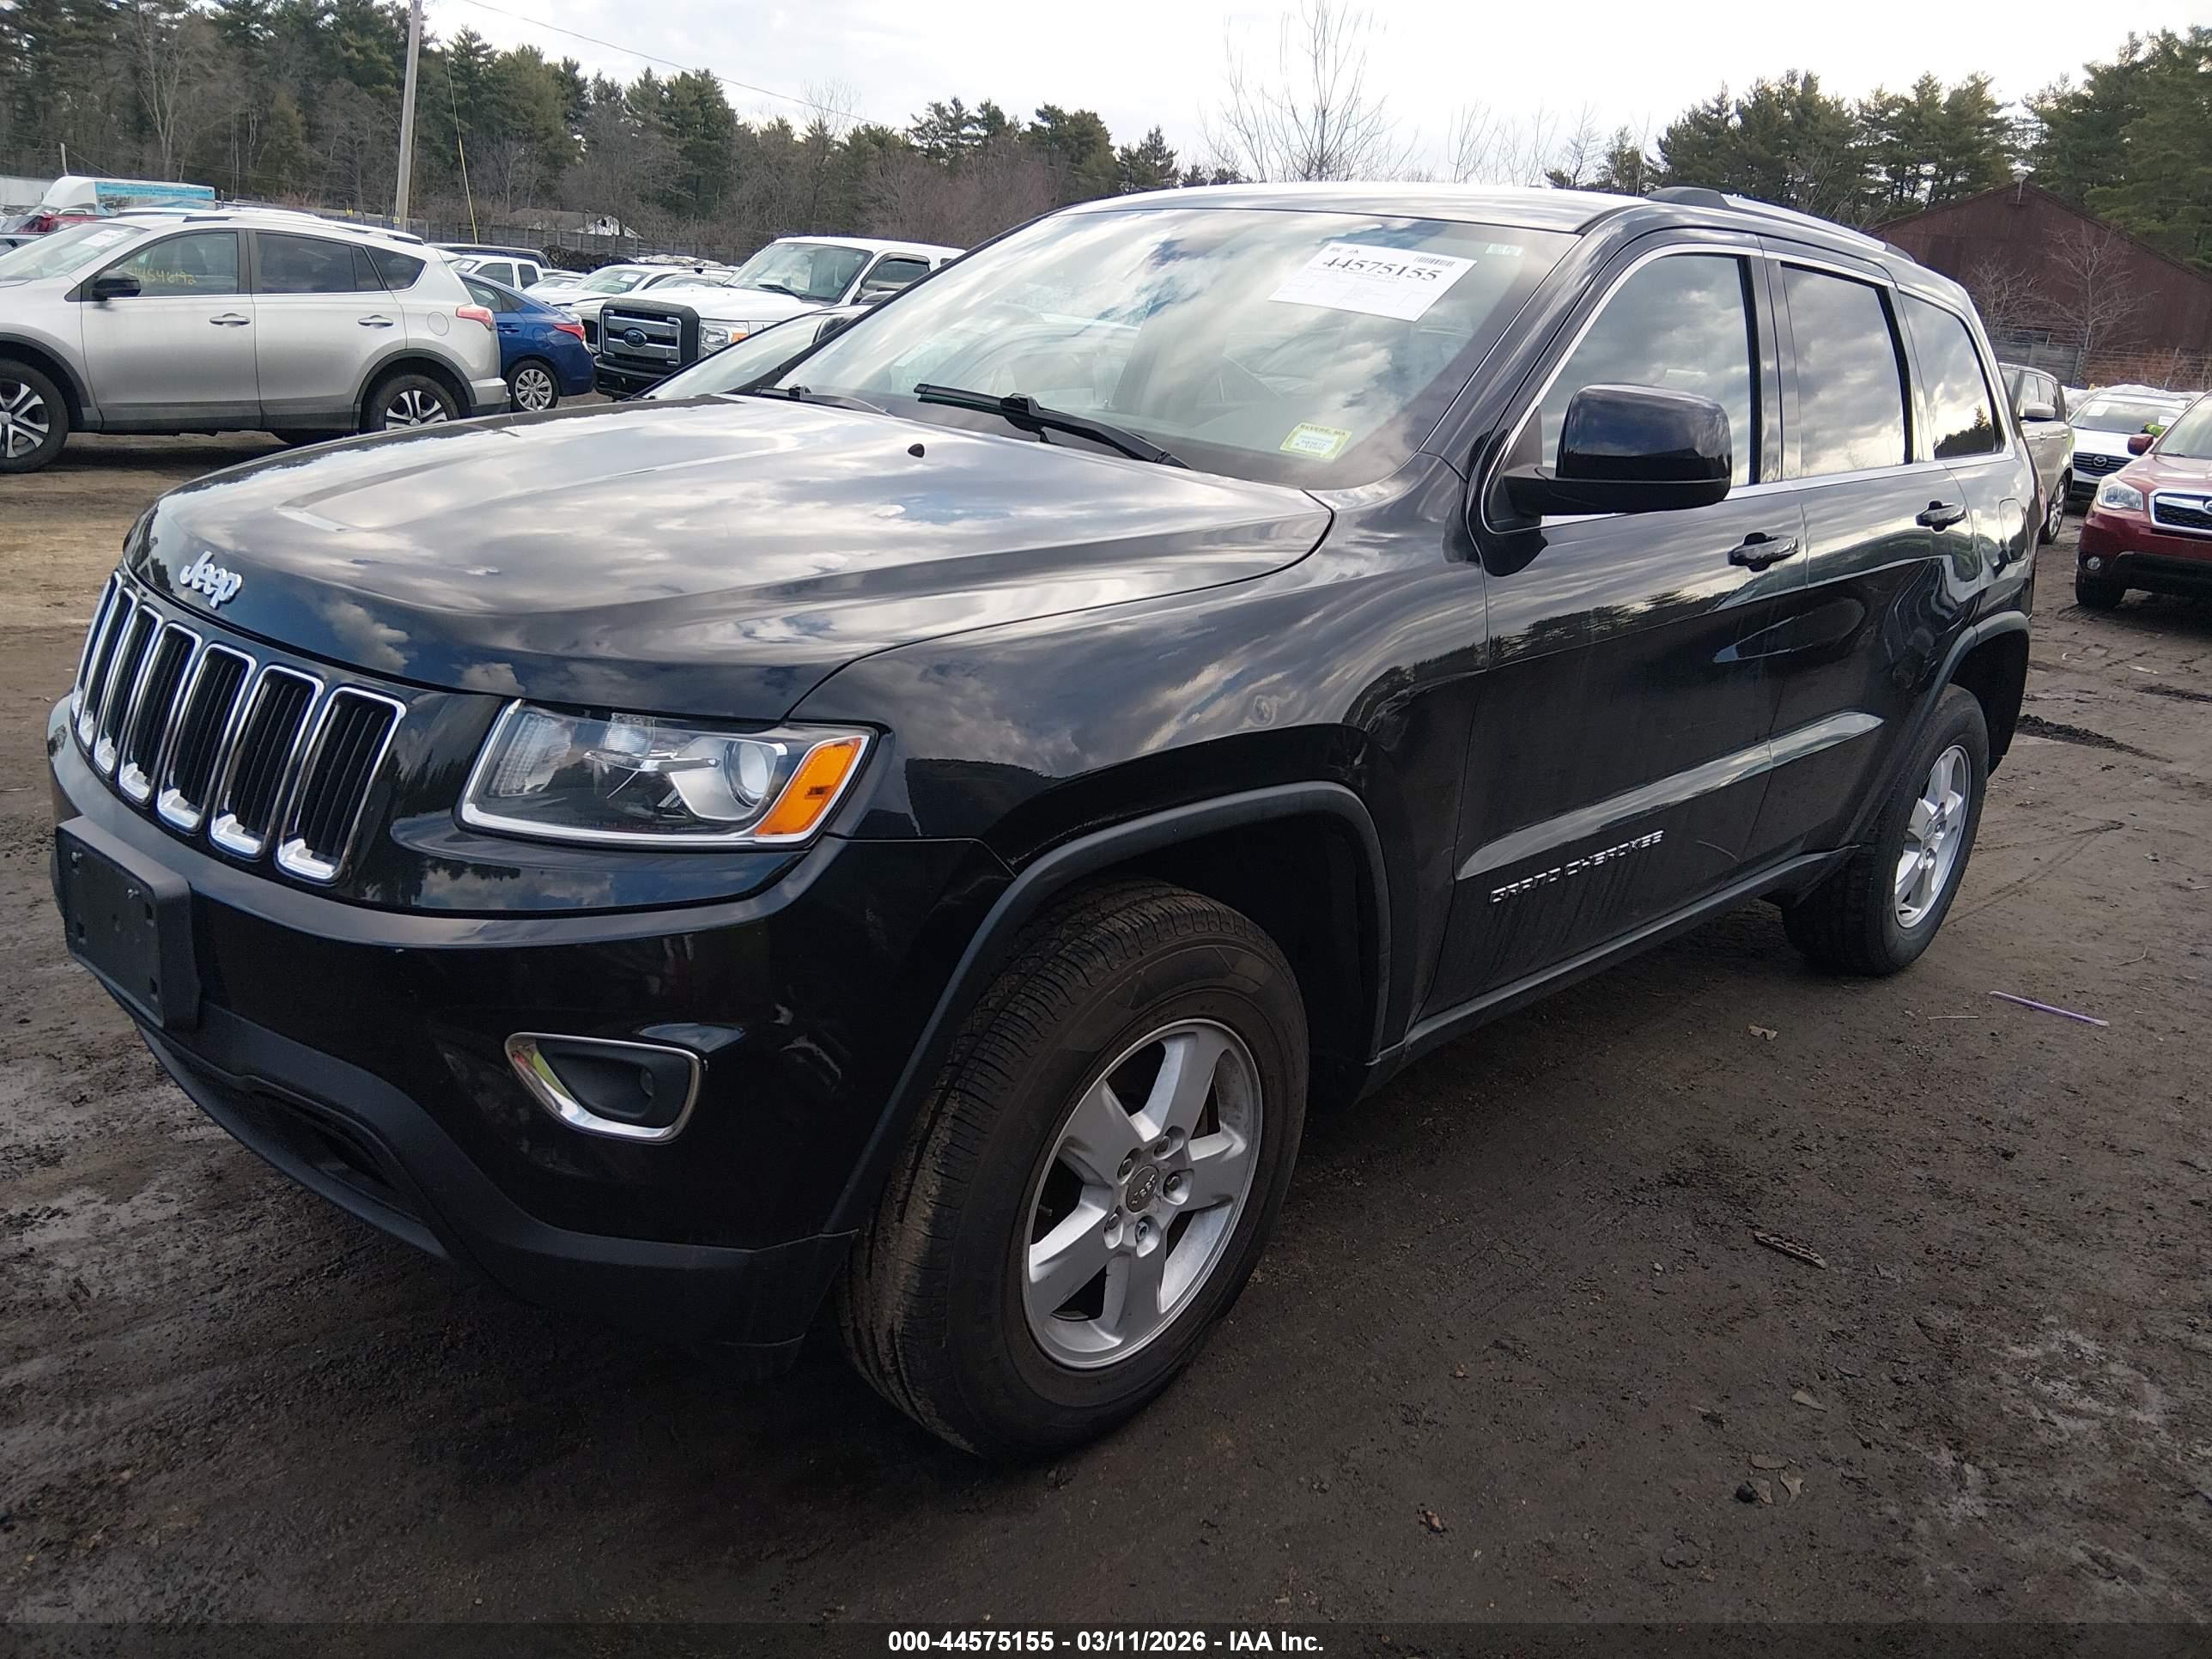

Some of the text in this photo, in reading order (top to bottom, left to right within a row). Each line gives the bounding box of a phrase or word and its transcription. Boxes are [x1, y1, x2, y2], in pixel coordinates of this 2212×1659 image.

[1322, 256, 1443, 282] 44575155
[179, 550, 242, 609] Jeep
[1490, 830, 1664, 903] GRAND CHEROKEE
